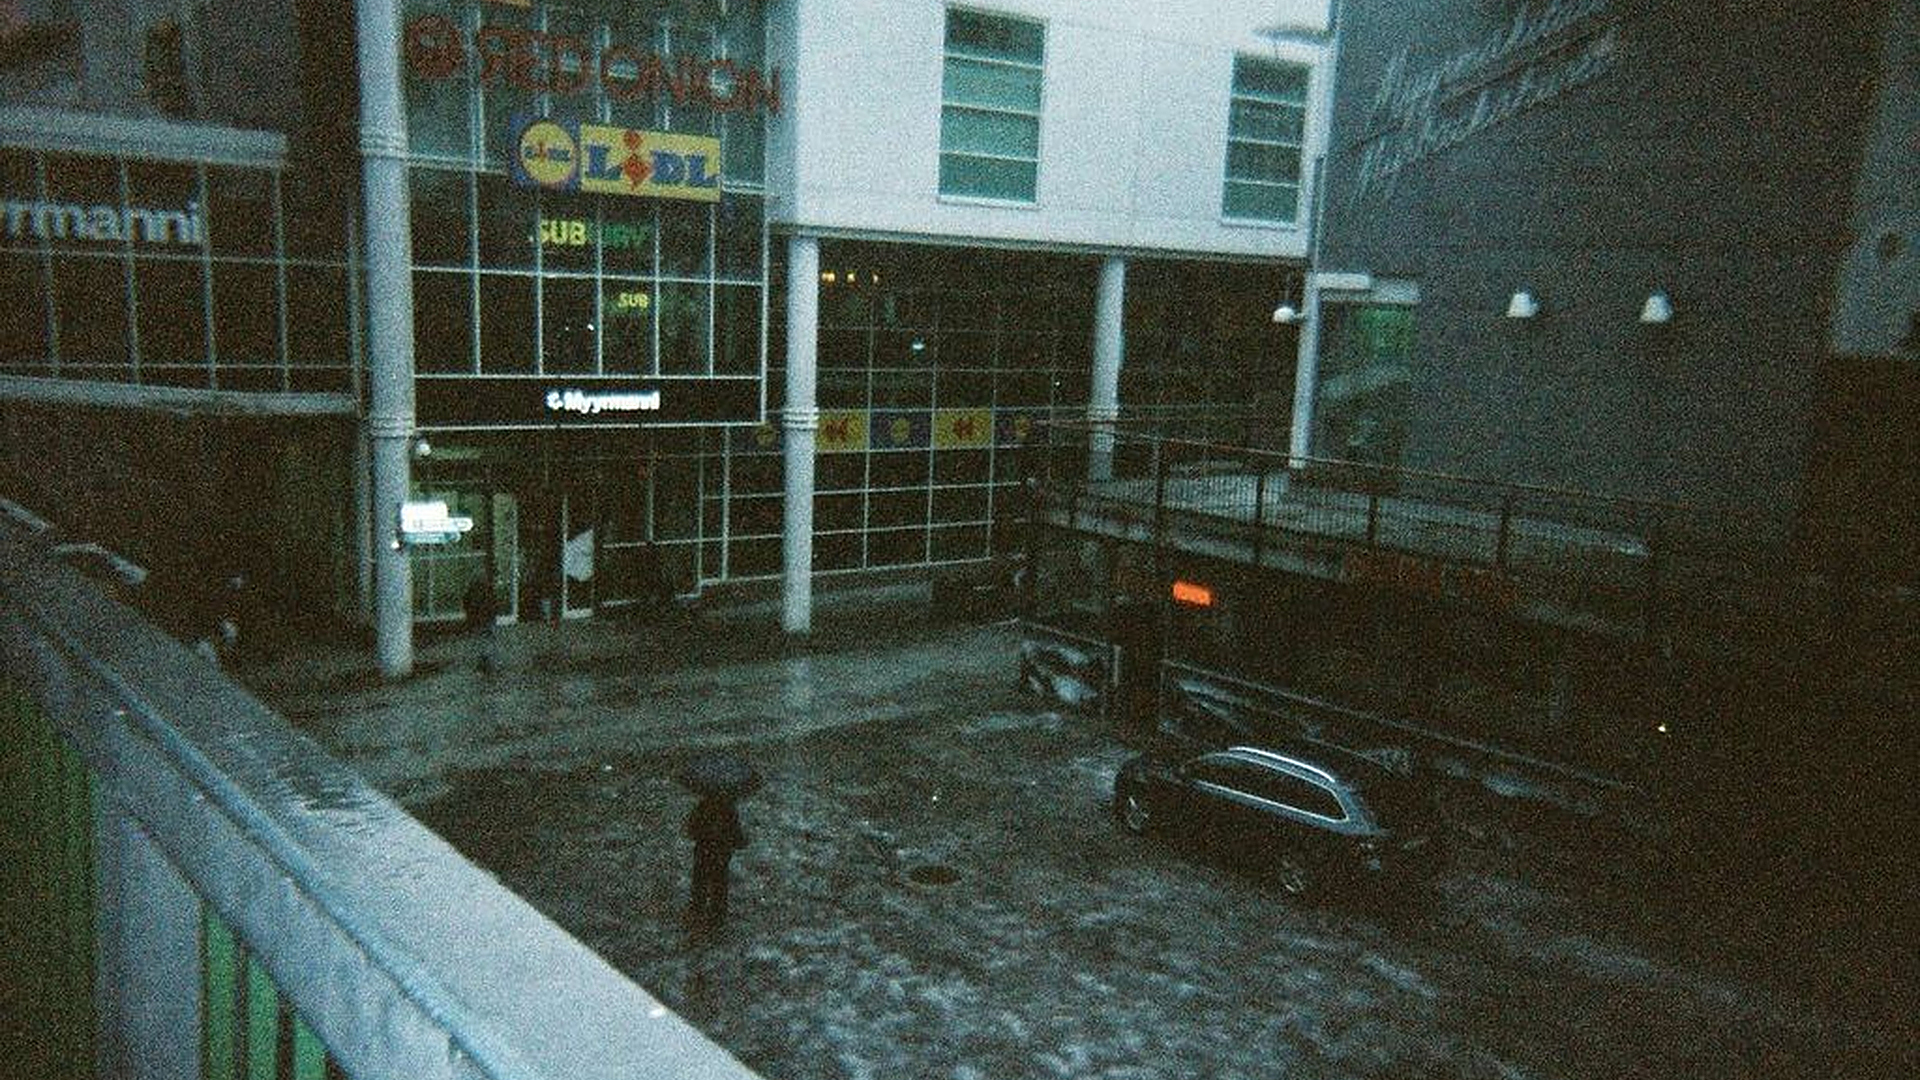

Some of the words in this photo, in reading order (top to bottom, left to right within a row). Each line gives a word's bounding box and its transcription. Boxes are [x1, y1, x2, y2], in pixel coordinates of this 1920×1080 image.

[478, 27, 592, 97] RED
[602, 45, 782, 116] ONION
[0, 198, 203, 243] rmanni
